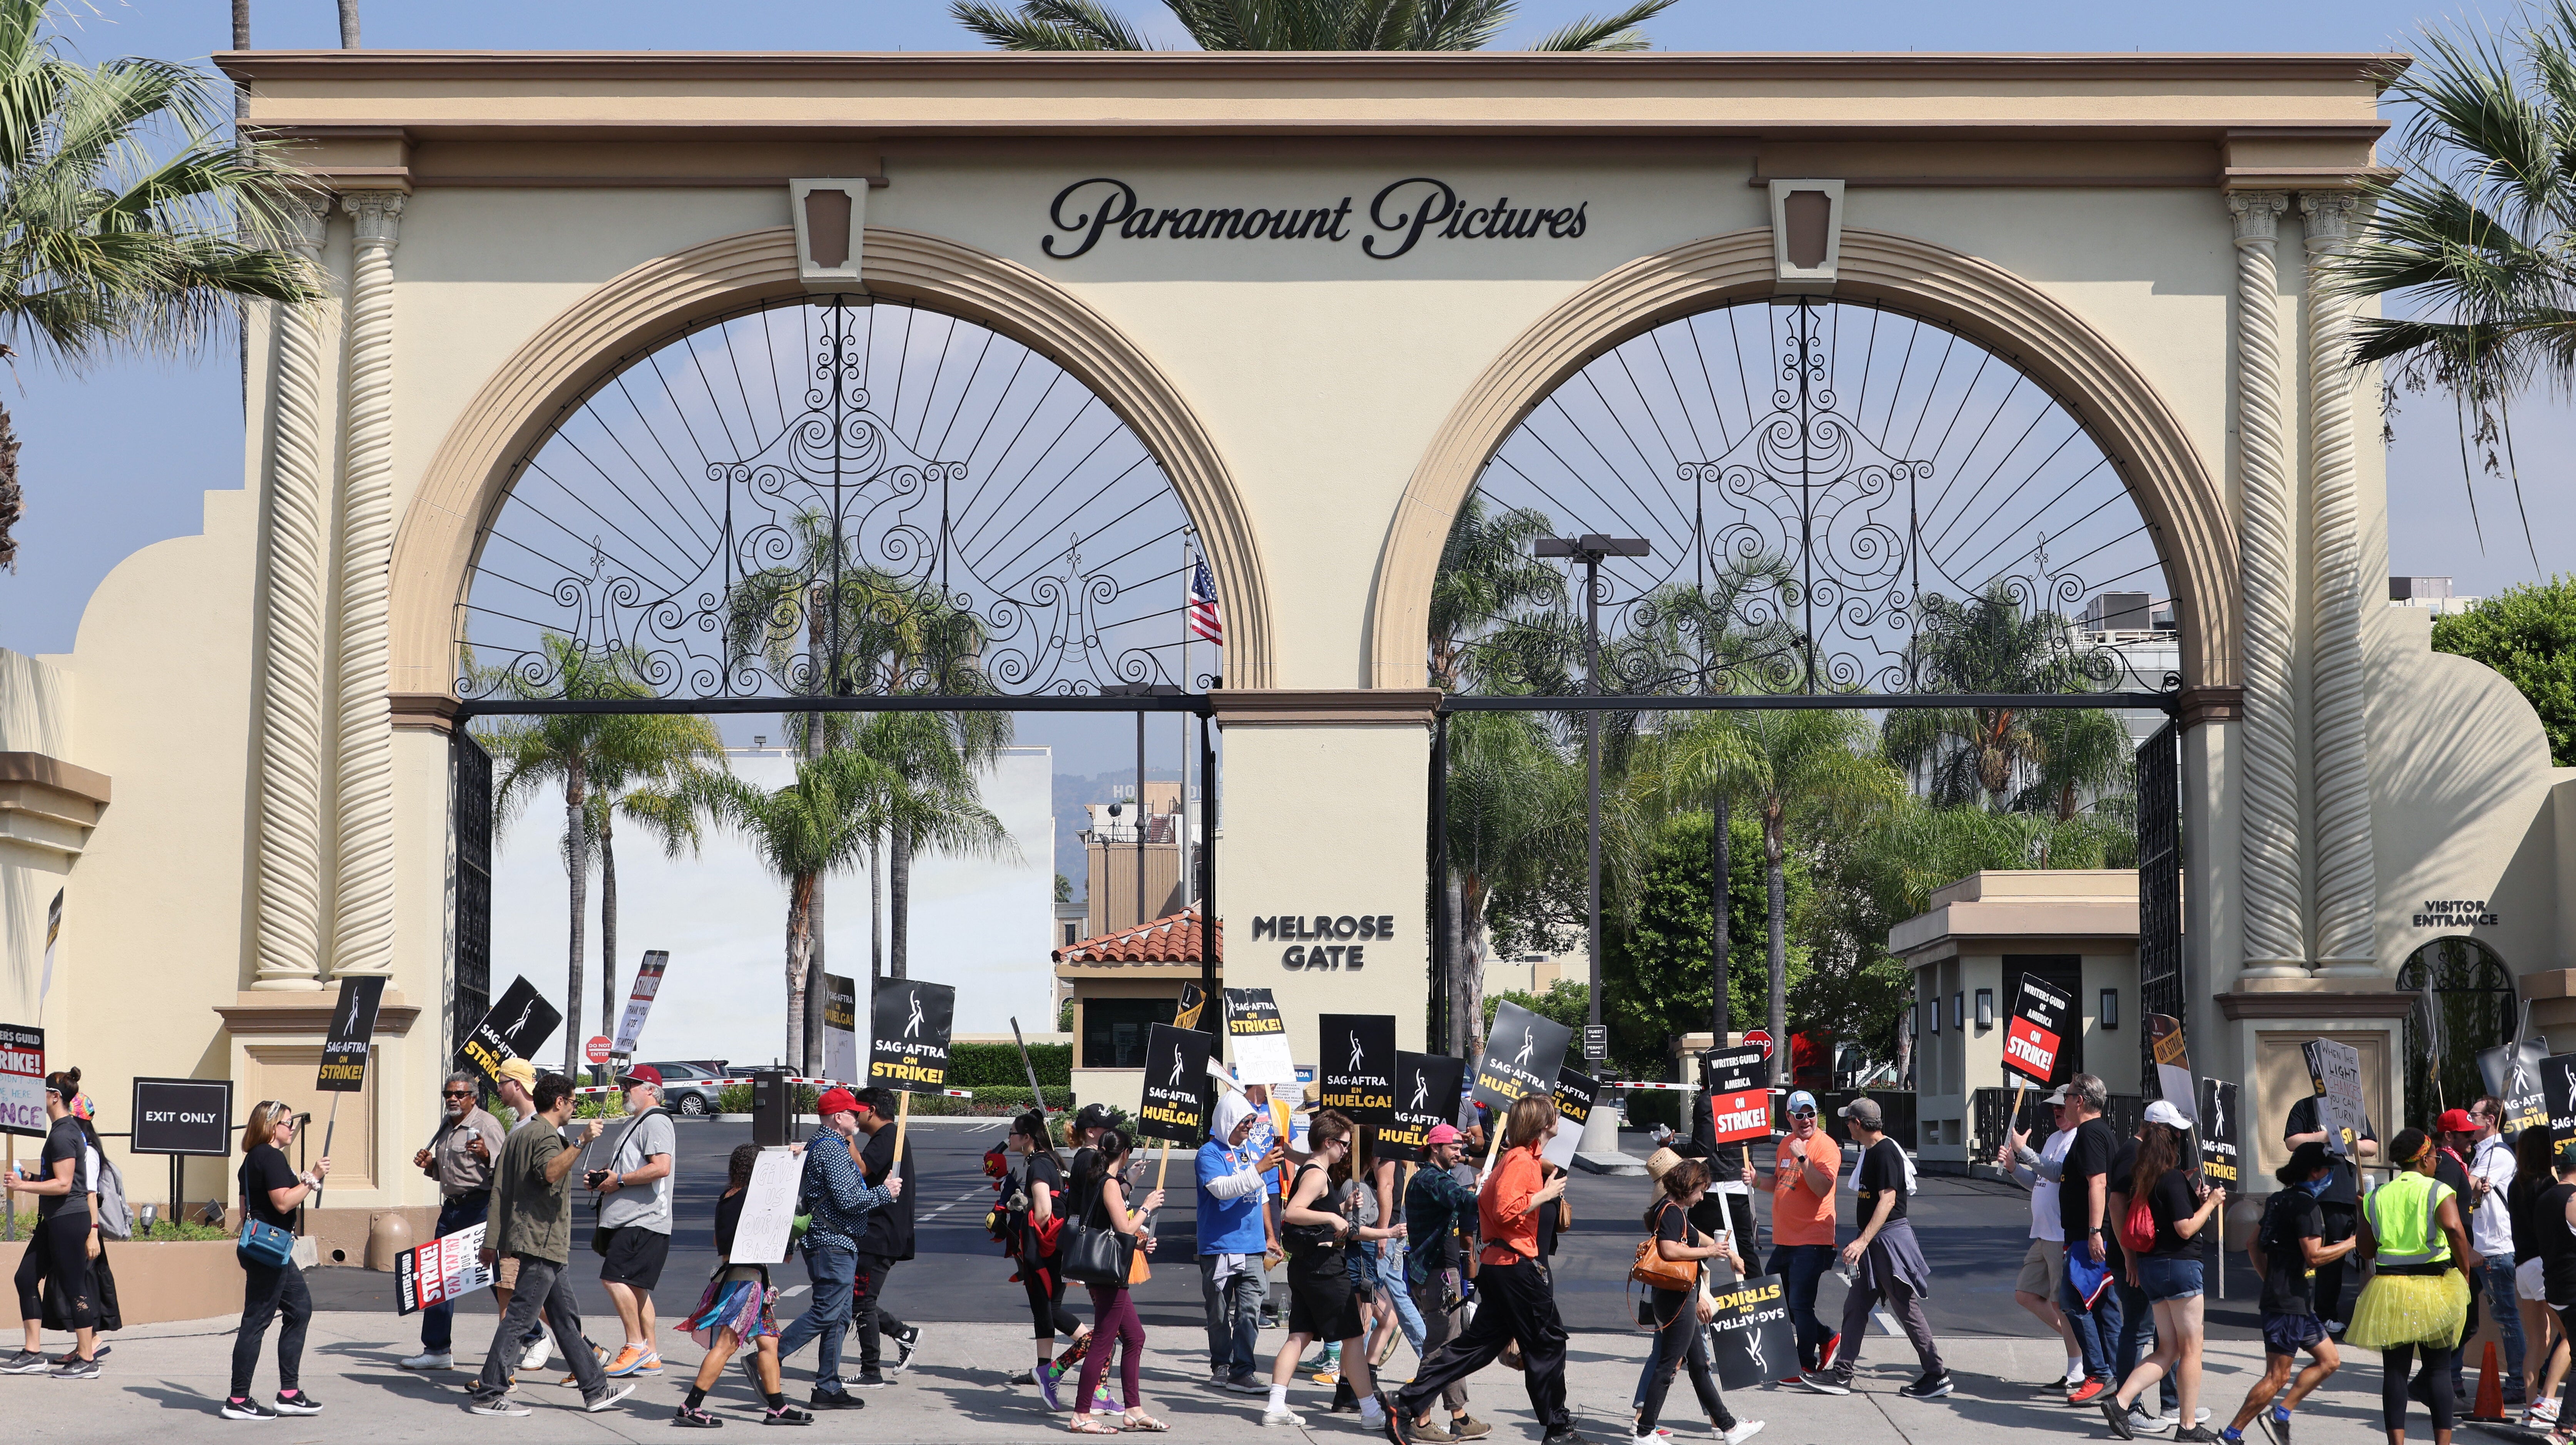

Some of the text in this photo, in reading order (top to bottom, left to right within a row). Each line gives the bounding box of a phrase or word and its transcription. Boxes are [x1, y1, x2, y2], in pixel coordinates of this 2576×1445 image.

[1042, 177, 1588, 259] Paramount Pictures
[2425, 900, 2486, 913] VISITOR
[1254, 915, 1394, 938] MELROSE
[2413, 914, 2498, 927] ENTRANCE
[1283, 945, 1364, 968] GATE
[633, 975, 661, 997] STRIKE!
[2024, 982, 2066, 1010] WRITERS GUILD
[627, 1005, 648, 1016] THANK YOU
[2039, 1003, 2046, 1012] OF
[825, 1008, 853, 1026] HUELGA!
[1230, 1018, 1282, 1033] STRIKE!
[2026, 1008, 2053, 1028] AMERICA
[15, 1033, 40, 1045] GUILD
[2029, 1030, 2042, 1044] ON
[491, 1050, 501, 1061] ON
[903, 1056, 918, 1065] ON
[2007, 1035, 2054, 1072] STRIKE!
[2157, 1044, 2168, 1061] ON
[2320, 1039, 2354, 1065] WHEN THE
[0, 1050, 41, 1075] RIKE!
[464, 1041, 500, 1083] STRIK
[1711, 1054, 1760, 1069] WRITERS GUILD
[319, 1064, 364, 1080] STRIKE!
[871, 1062, 944, 1084] STRIKE!
[1733, 1068, 1739, 1077] OF
[2329, 1060, 2357, 1083] LIGHT
[1478, 1073, 1529, 1100] HUEL
[1510, 1077, 1522, 1087] EN
[1724, 1077, 1751, 1090] AMERICA
[2329, 1076, 2363, 1102] CHANGES
[12, 1089, 32, 1099] HERE
[1322, 1094, 1392, 1108] HUELGA!
[1554, 1090, 1565, 1099] EN
[1735, 1097, 1745, 1109] ON
[2329, 1094, 2356, 1111] YOU CAN
[1168, 1101, 1178, 1109] EN
[2524, 1106, 2538, 1115] ON
[0, 1102, 43, 1128] NCE
[146, 1111, 216, 1124] EXIT ONLY
[1142, 1105, 1199, 1127] HUELGA!
[1717, 1107, 1767, 1134] STRIKE!
[2332, 1107, 2354, 1125] TURN
[2503, 1112, 2549, 1134] STRIK
[1378, 1128, 1429, 1146] HUEL
[2216, 1155, 2225, 1163] ON
[2203, 1161, 2237, 1181] STRIKE!
[765, 1187, 786, 1208] US
[741, 1214, 773, 1236] OUR
[445, 1238, 460, 1253] PAY
[741, 1238, 779, 1260] BACK
[461, 1253, 471, 1272] YOUR
[401, 1253, 415, 1311] WRITERS GUILD
[413, 1271, 420, 1281] ON
[419, 1243, 442, 1303] STRIKE!
[1713, 1284, 1781, 1310] STRIKE
[1739, 1304, 1755, 1314] ON
[1936, 1376, 1950, 1386] HOKA
